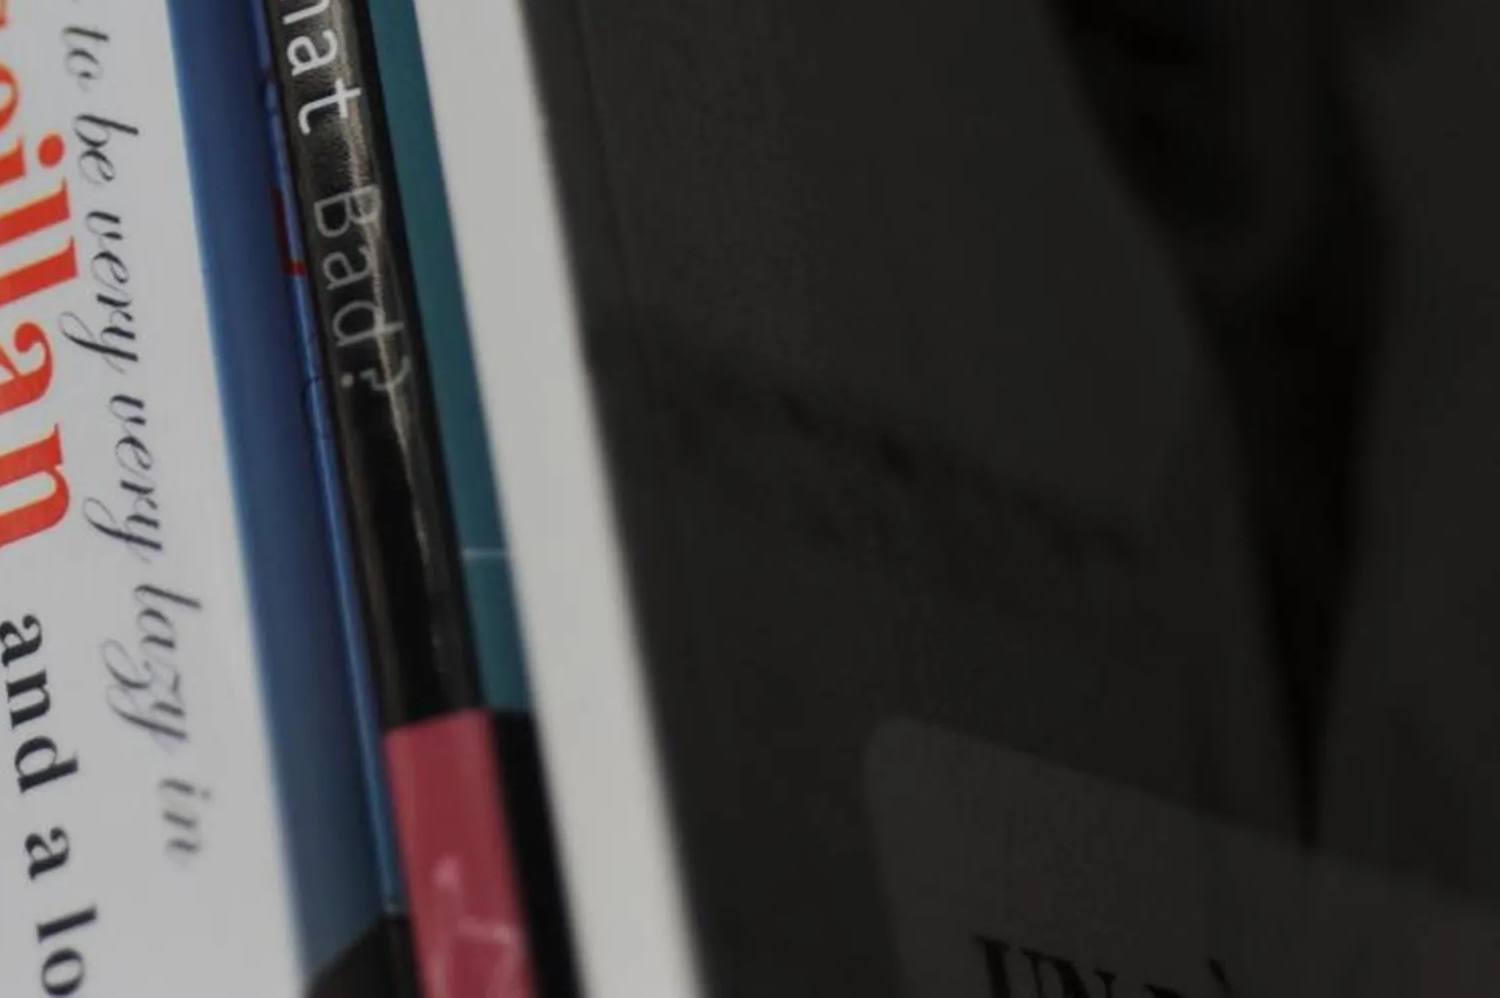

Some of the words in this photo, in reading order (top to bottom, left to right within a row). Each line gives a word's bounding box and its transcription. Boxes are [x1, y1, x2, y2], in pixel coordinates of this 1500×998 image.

[60, 23, 110, 90] to
[73, 111, 140, 187] be
[58, 209, 140, 374] very
[313, 183, 411, 390] Bad?
[82, 393, 164, 564] very
[99, 582, 203, 752] lazy
[24, 826, 71, 881] a
[158, 777, 213, 868] in
[35, 903, 99, 997] lo
